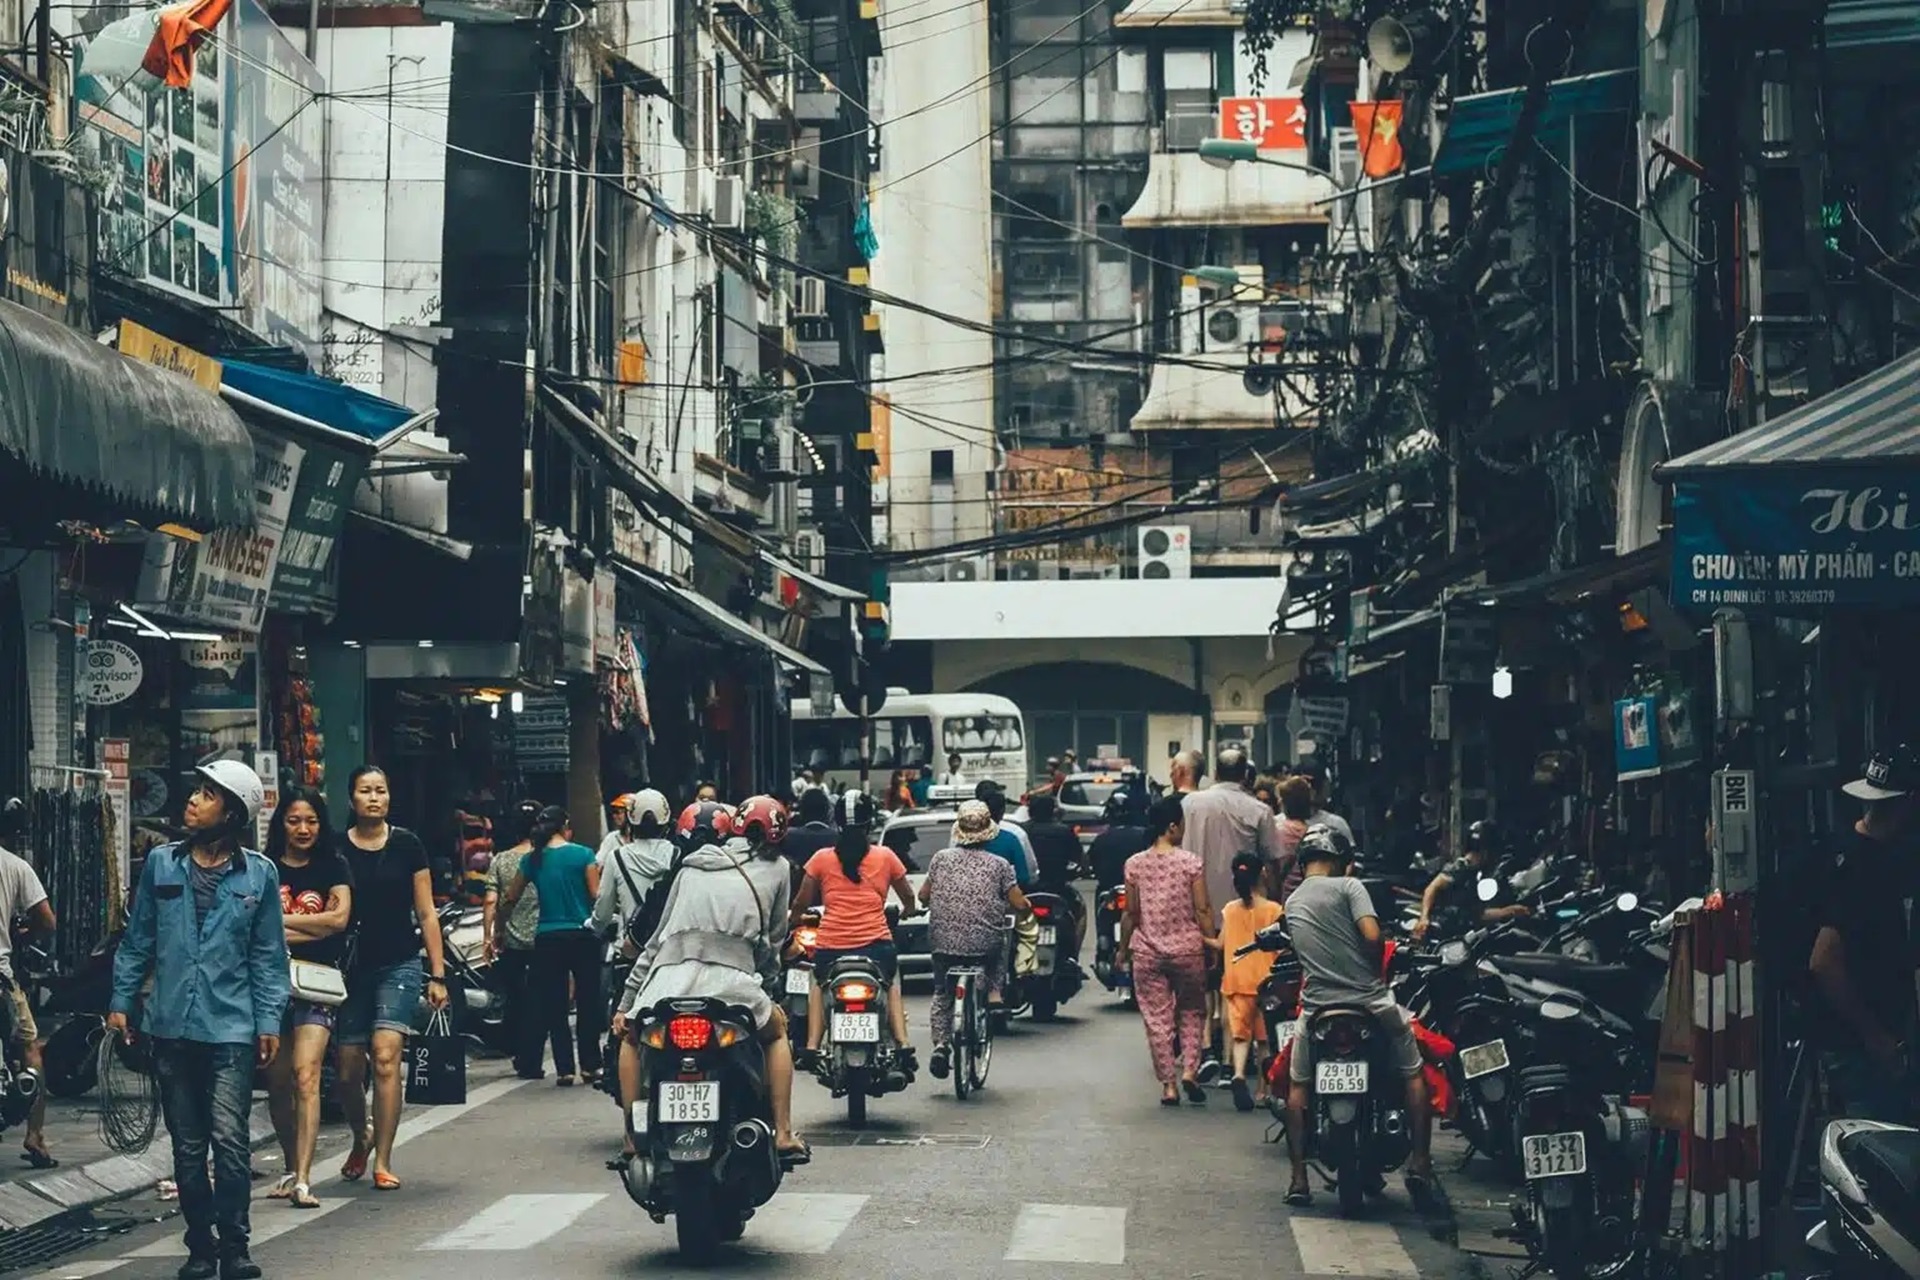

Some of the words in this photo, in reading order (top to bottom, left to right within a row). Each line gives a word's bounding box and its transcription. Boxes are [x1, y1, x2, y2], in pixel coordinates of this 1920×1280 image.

[1777, 549, 1810, 580] MỸ
[1814, 541, 1874, 580] PHẨM
[1692, 589, 1707, 604] CH
[115, 644, 140, 667] TOURS
[190, 648, 243, 661] Island
[1725, 775, 1747, 812] BNE
[840, 1015, 871, 1027] 29-E2
[838, 1027, 875, 1039] 107.18
[414, 1047, 430, 1087] SALE
[1324, 1065, 1360, 1078] 29-D1
[1319, 1078, 1365, 1091] 066.59
[668, 1085, 711, 1101] 30-H7
[668, 1103, 711, 1120] 1855
[1532, 1154, 1578, 1175] 3121
